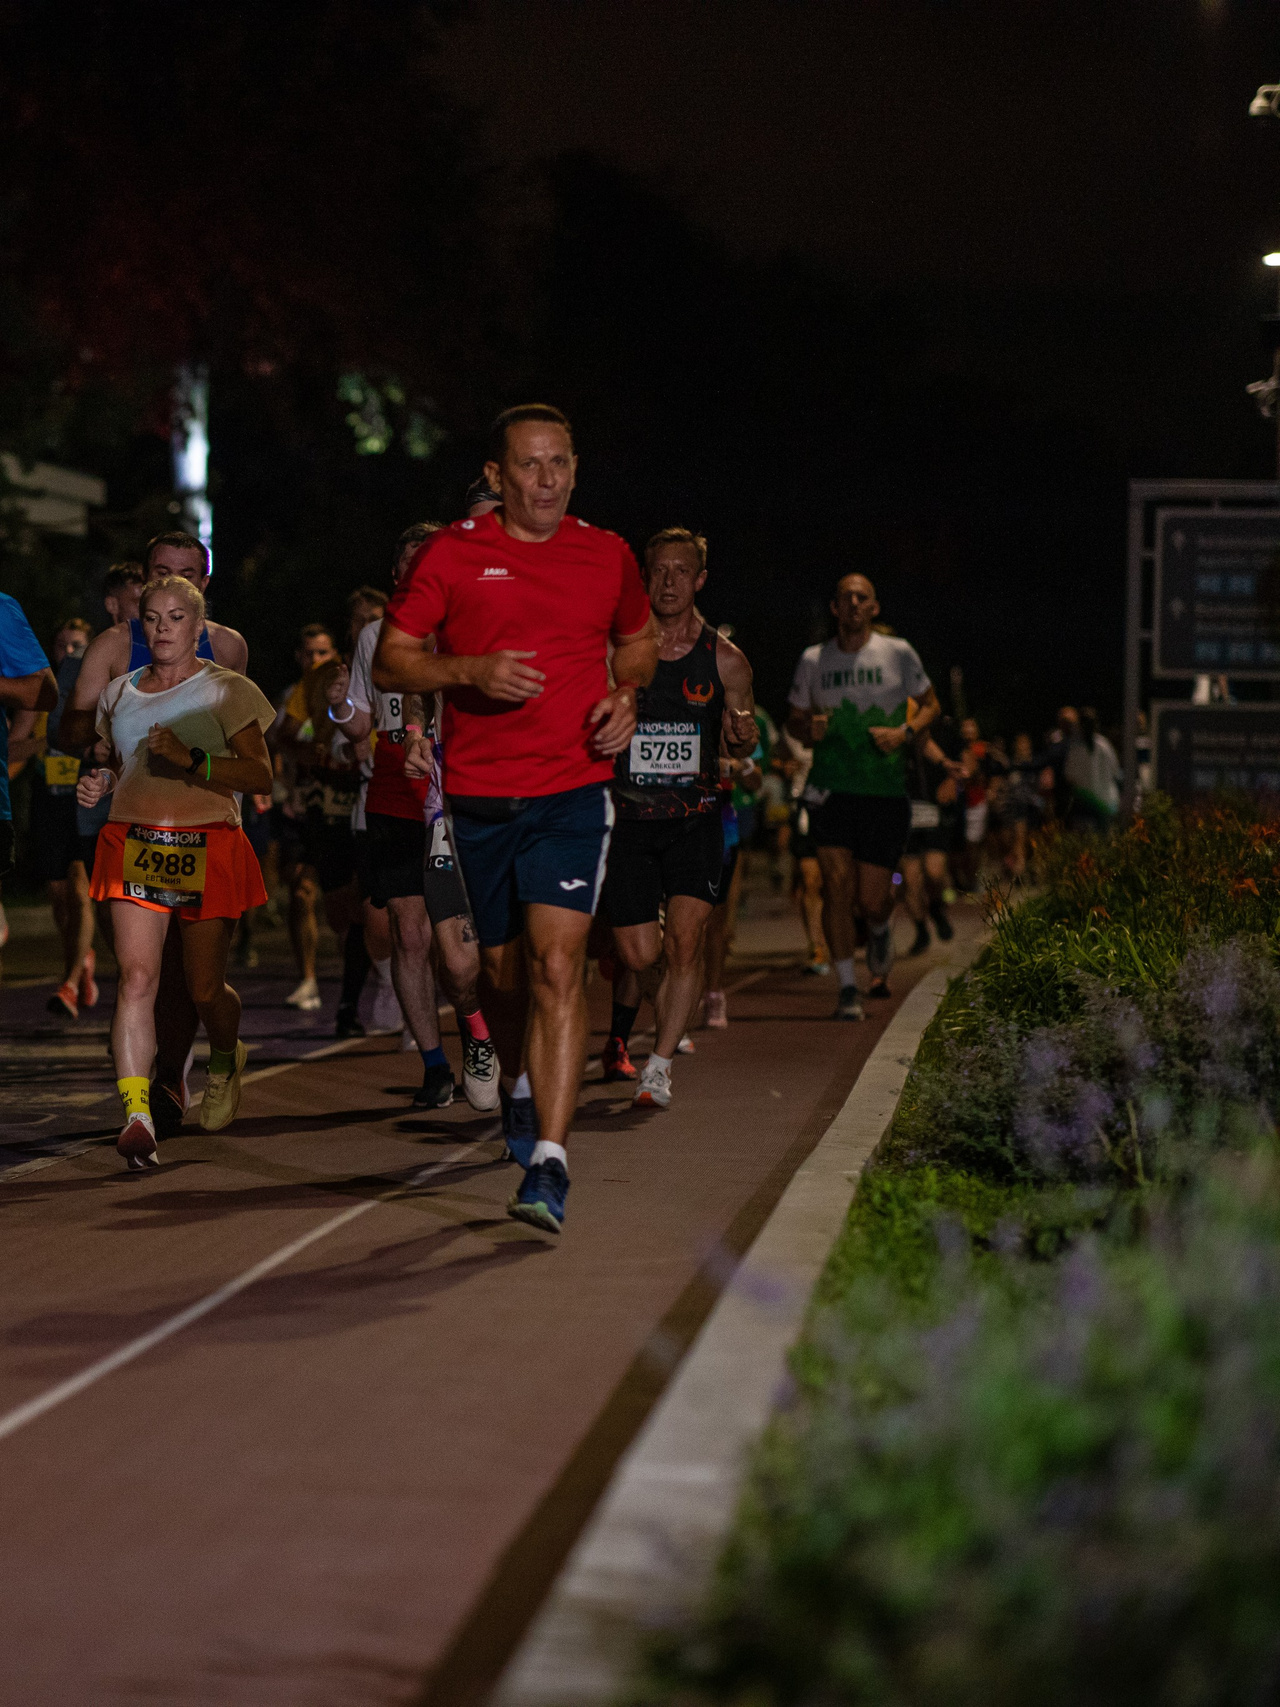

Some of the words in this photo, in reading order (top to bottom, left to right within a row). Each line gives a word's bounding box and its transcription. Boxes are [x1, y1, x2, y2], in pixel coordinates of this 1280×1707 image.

[640, 742, 692, 761] 5785
[133, 848, 197, 876] 4988
[145, 874, 182, 885] ЕВГЕНИЯ
